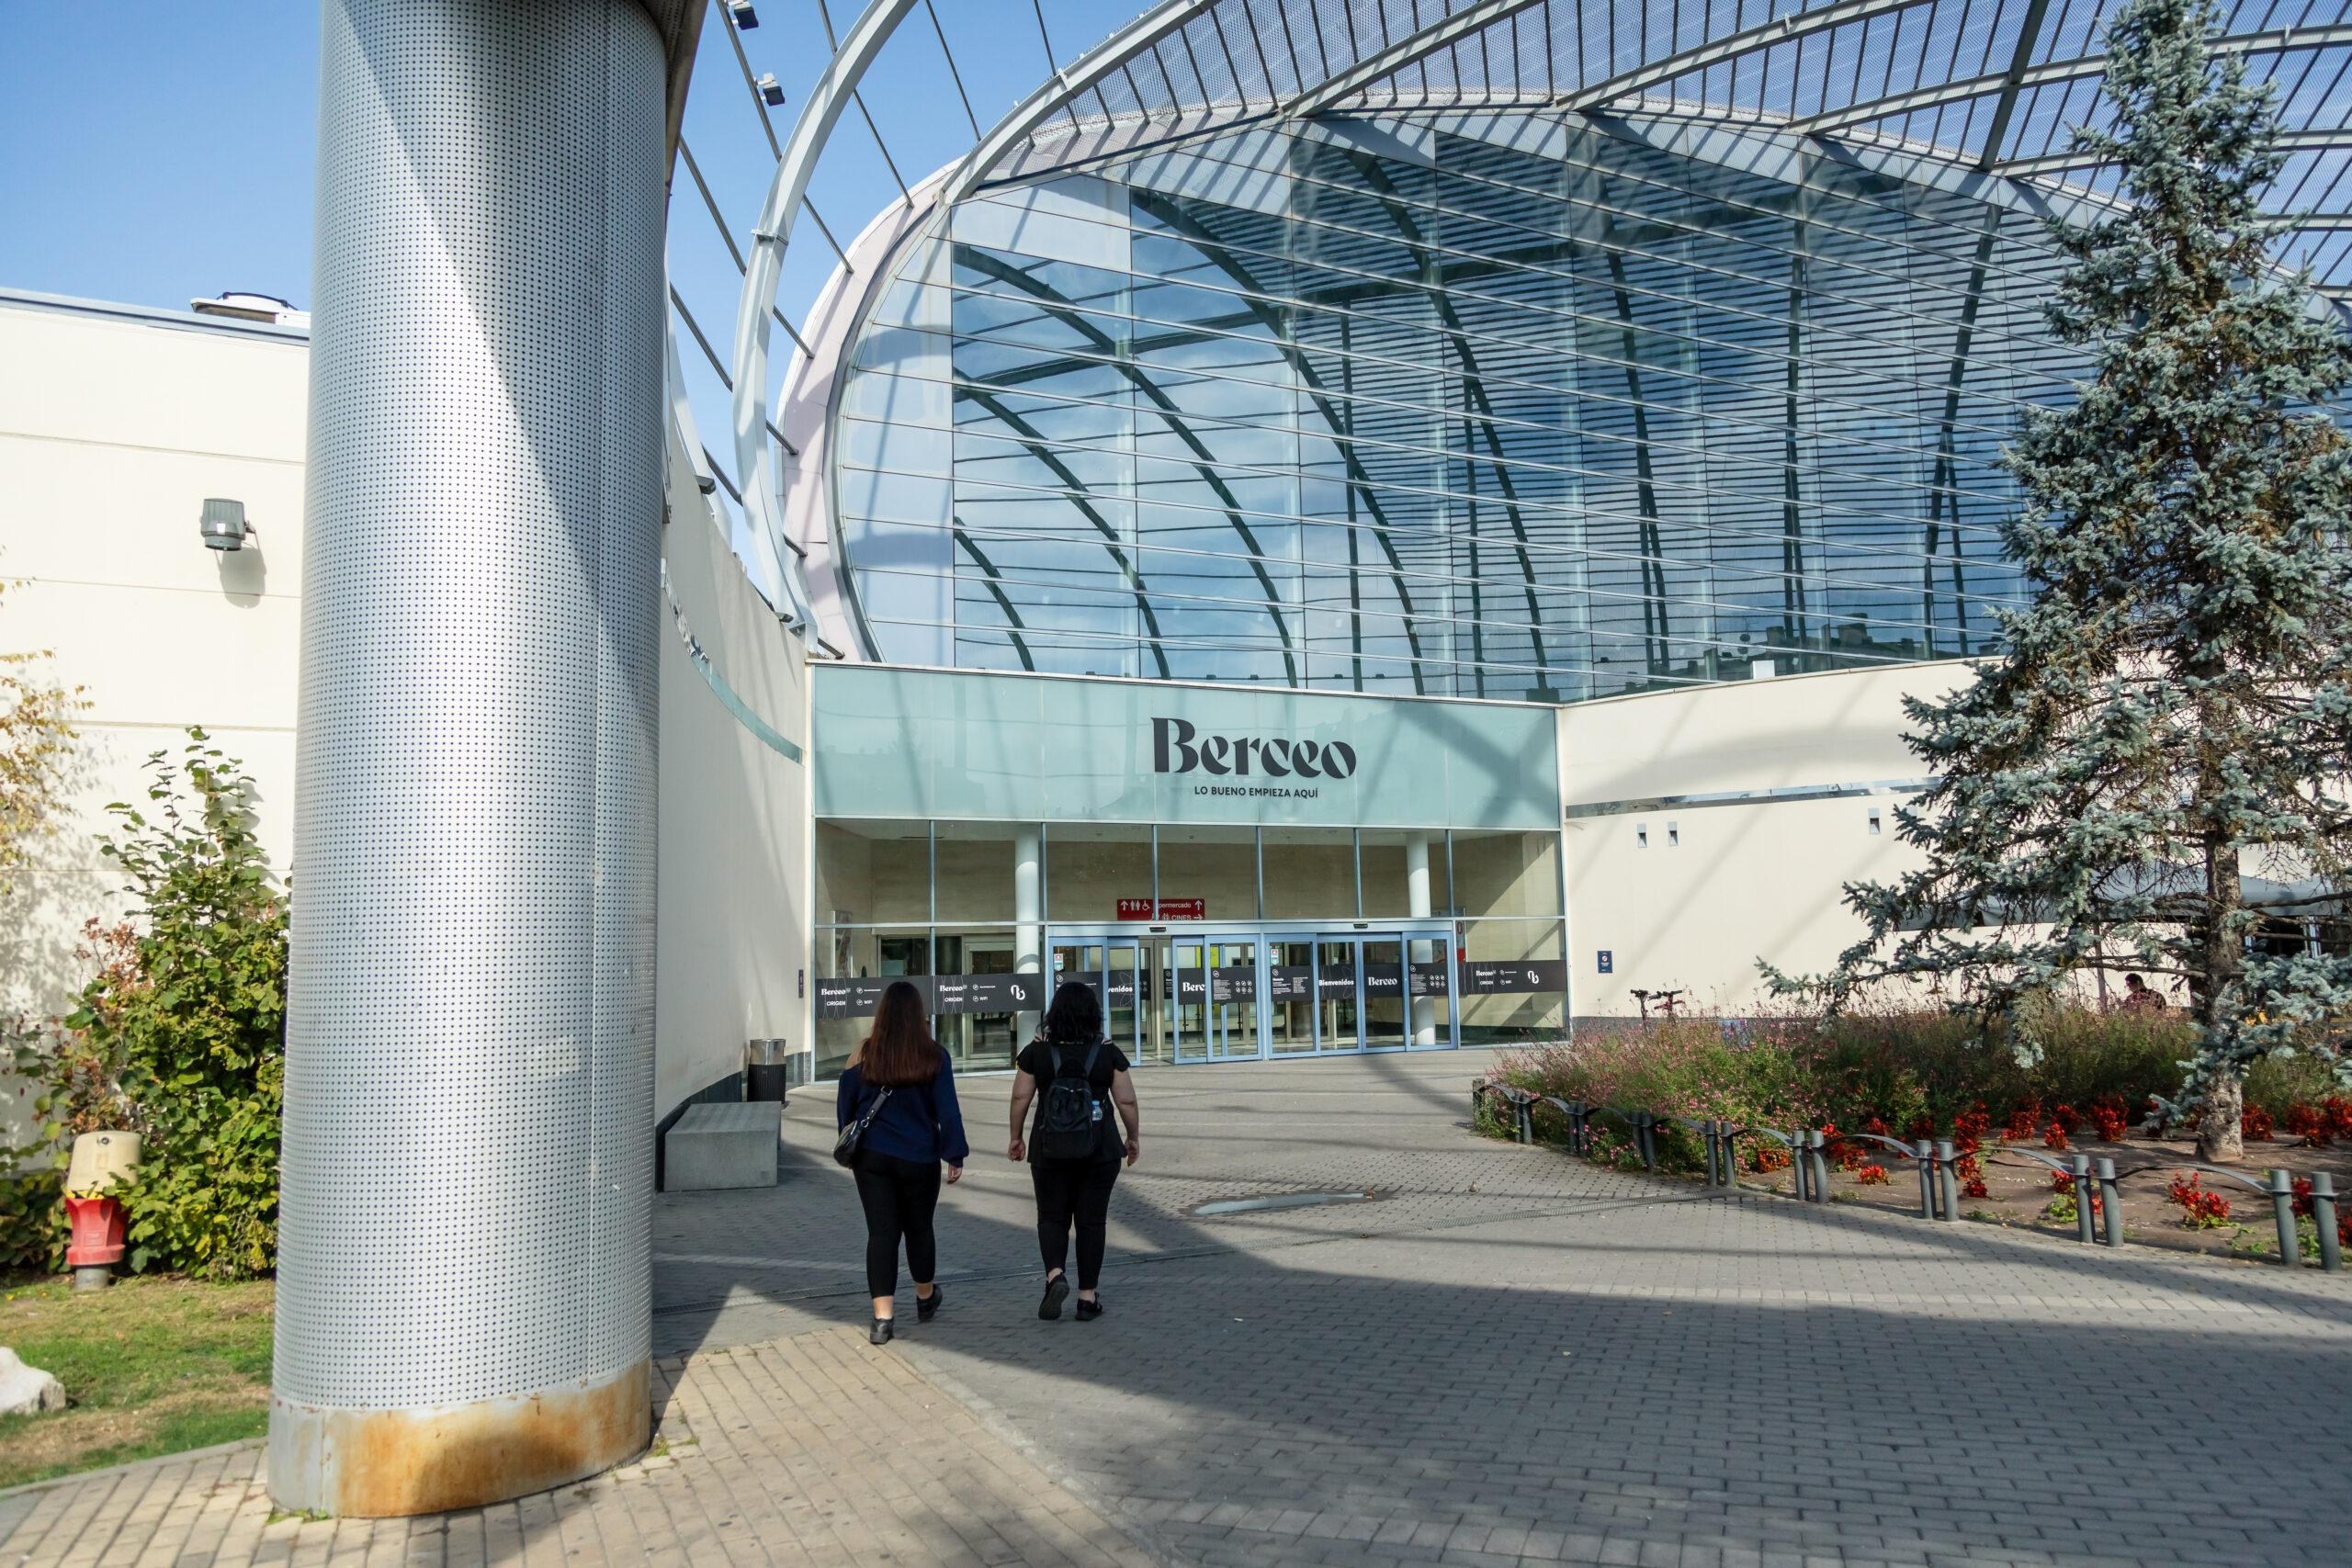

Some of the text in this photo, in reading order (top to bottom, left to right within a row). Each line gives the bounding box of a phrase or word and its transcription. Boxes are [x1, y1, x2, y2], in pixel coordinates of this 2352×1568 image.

[1150, 716, 1357, 779] Berceo
[1194, 785, 1318, 799] LO BUENO EMPIEZA AQUÍ
[1318, 978, 1355, 987] Bienvenidos
[1368, 976, 1397, 986] Berceo
[1182, 982, 1205, 992] Berc
